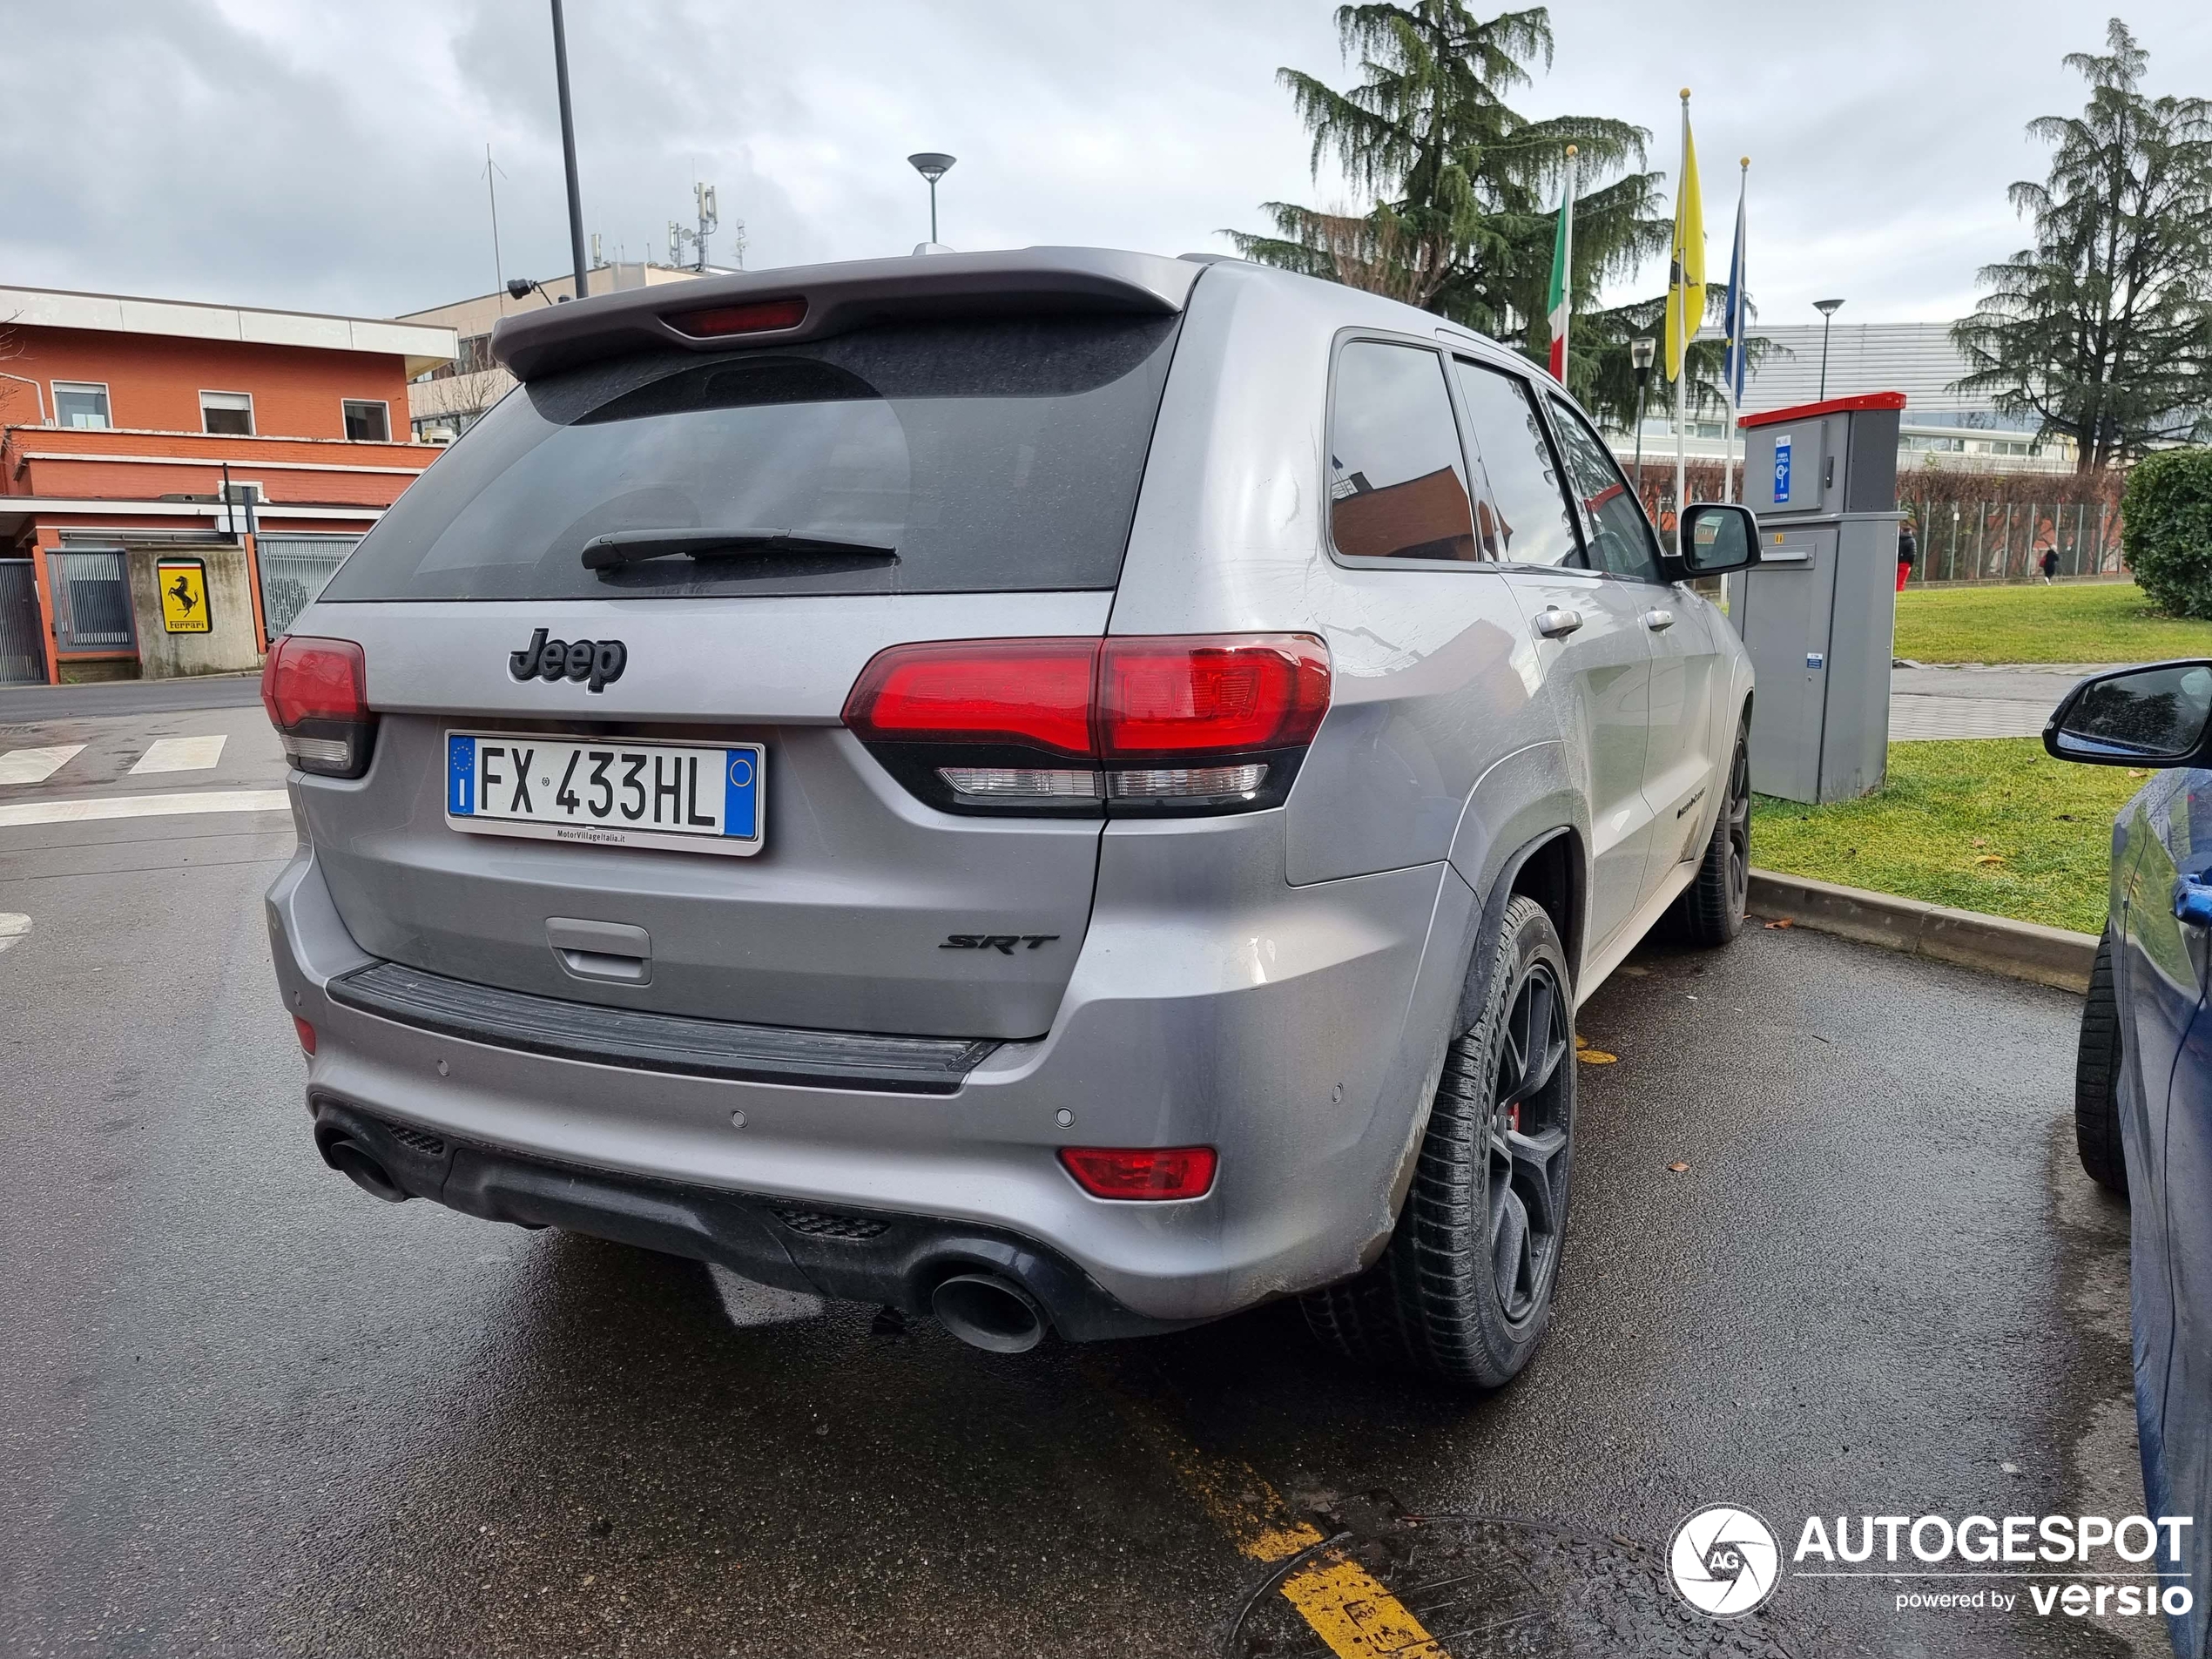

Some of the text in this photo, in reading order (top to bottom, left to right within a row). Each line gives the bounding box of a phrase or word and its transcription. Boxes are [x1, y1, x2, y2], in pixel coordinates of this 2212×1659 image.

[170, 620, 205, 629] Ferrari
[509, 628, 627, 692] Jeep
[481, 747, 535, 813] FX
[556, 750, 716, 826] 433HL
[557, 829, 625, 843] MotorVillageItalia.it
[938, 934, 1060, 955] SRT
